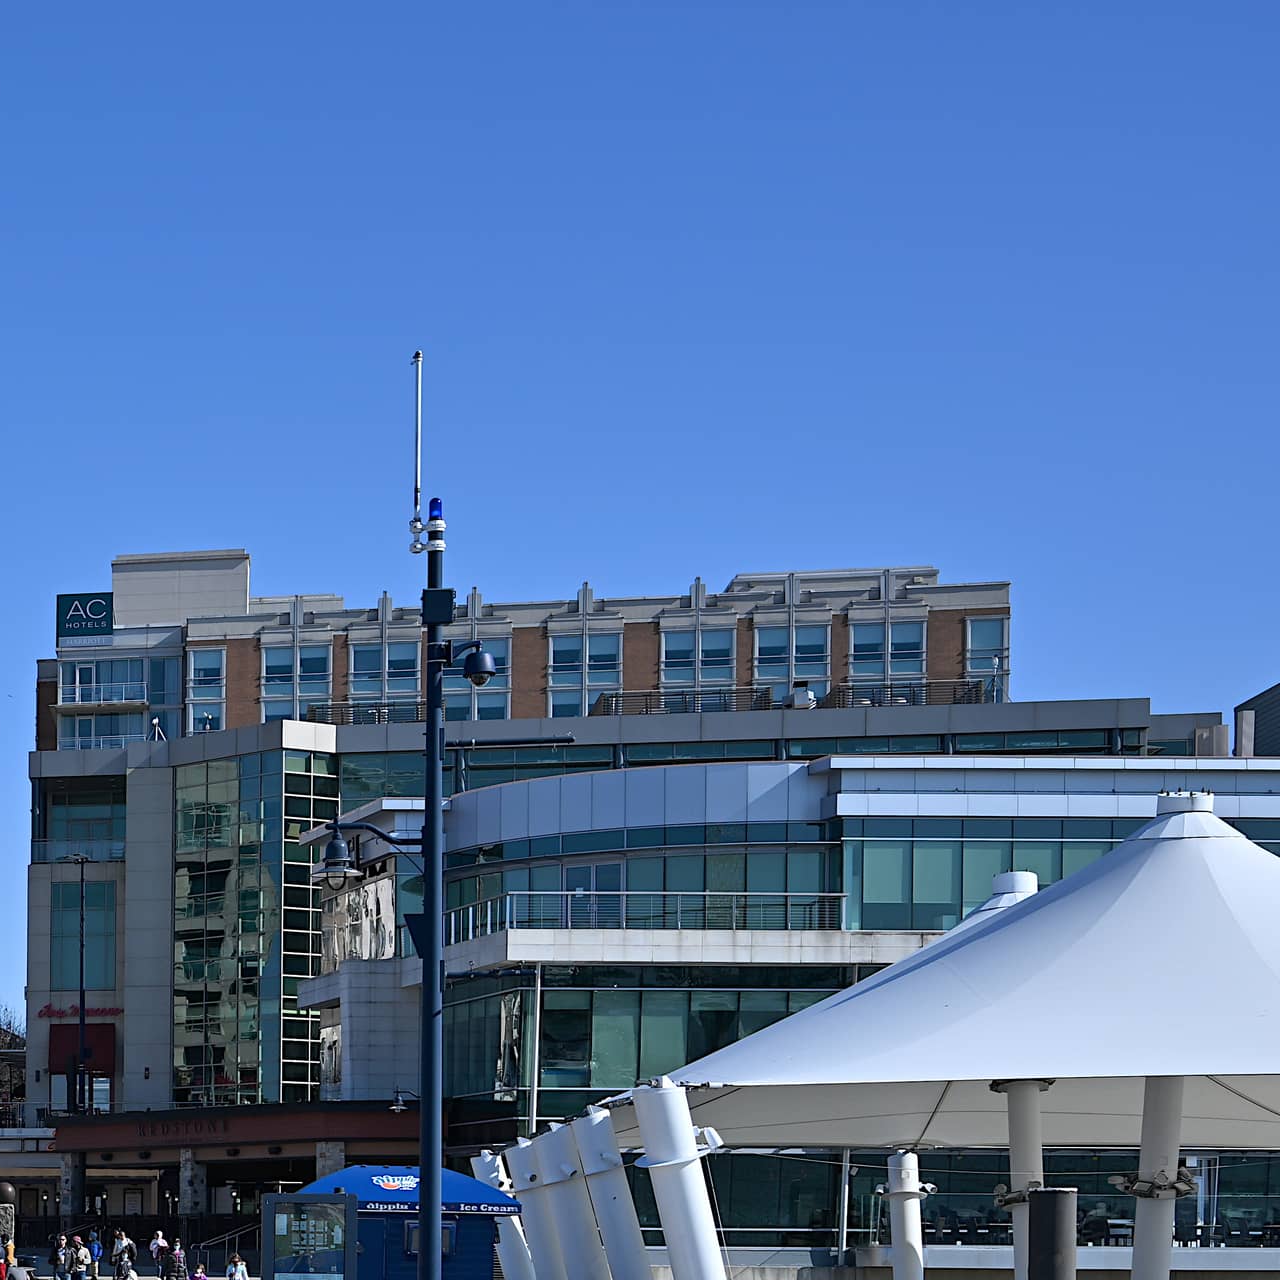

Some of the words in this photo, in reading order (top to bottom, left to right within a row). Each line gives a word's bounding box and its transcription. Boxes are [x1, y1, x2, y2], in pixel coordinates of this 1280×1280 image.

[66, 599, 107, 620] AC
[65, 621, 107, 629] HOTELS
[460, 1203, 478, 1211] Ice
[480, 1204, 519, 1212] Cream
